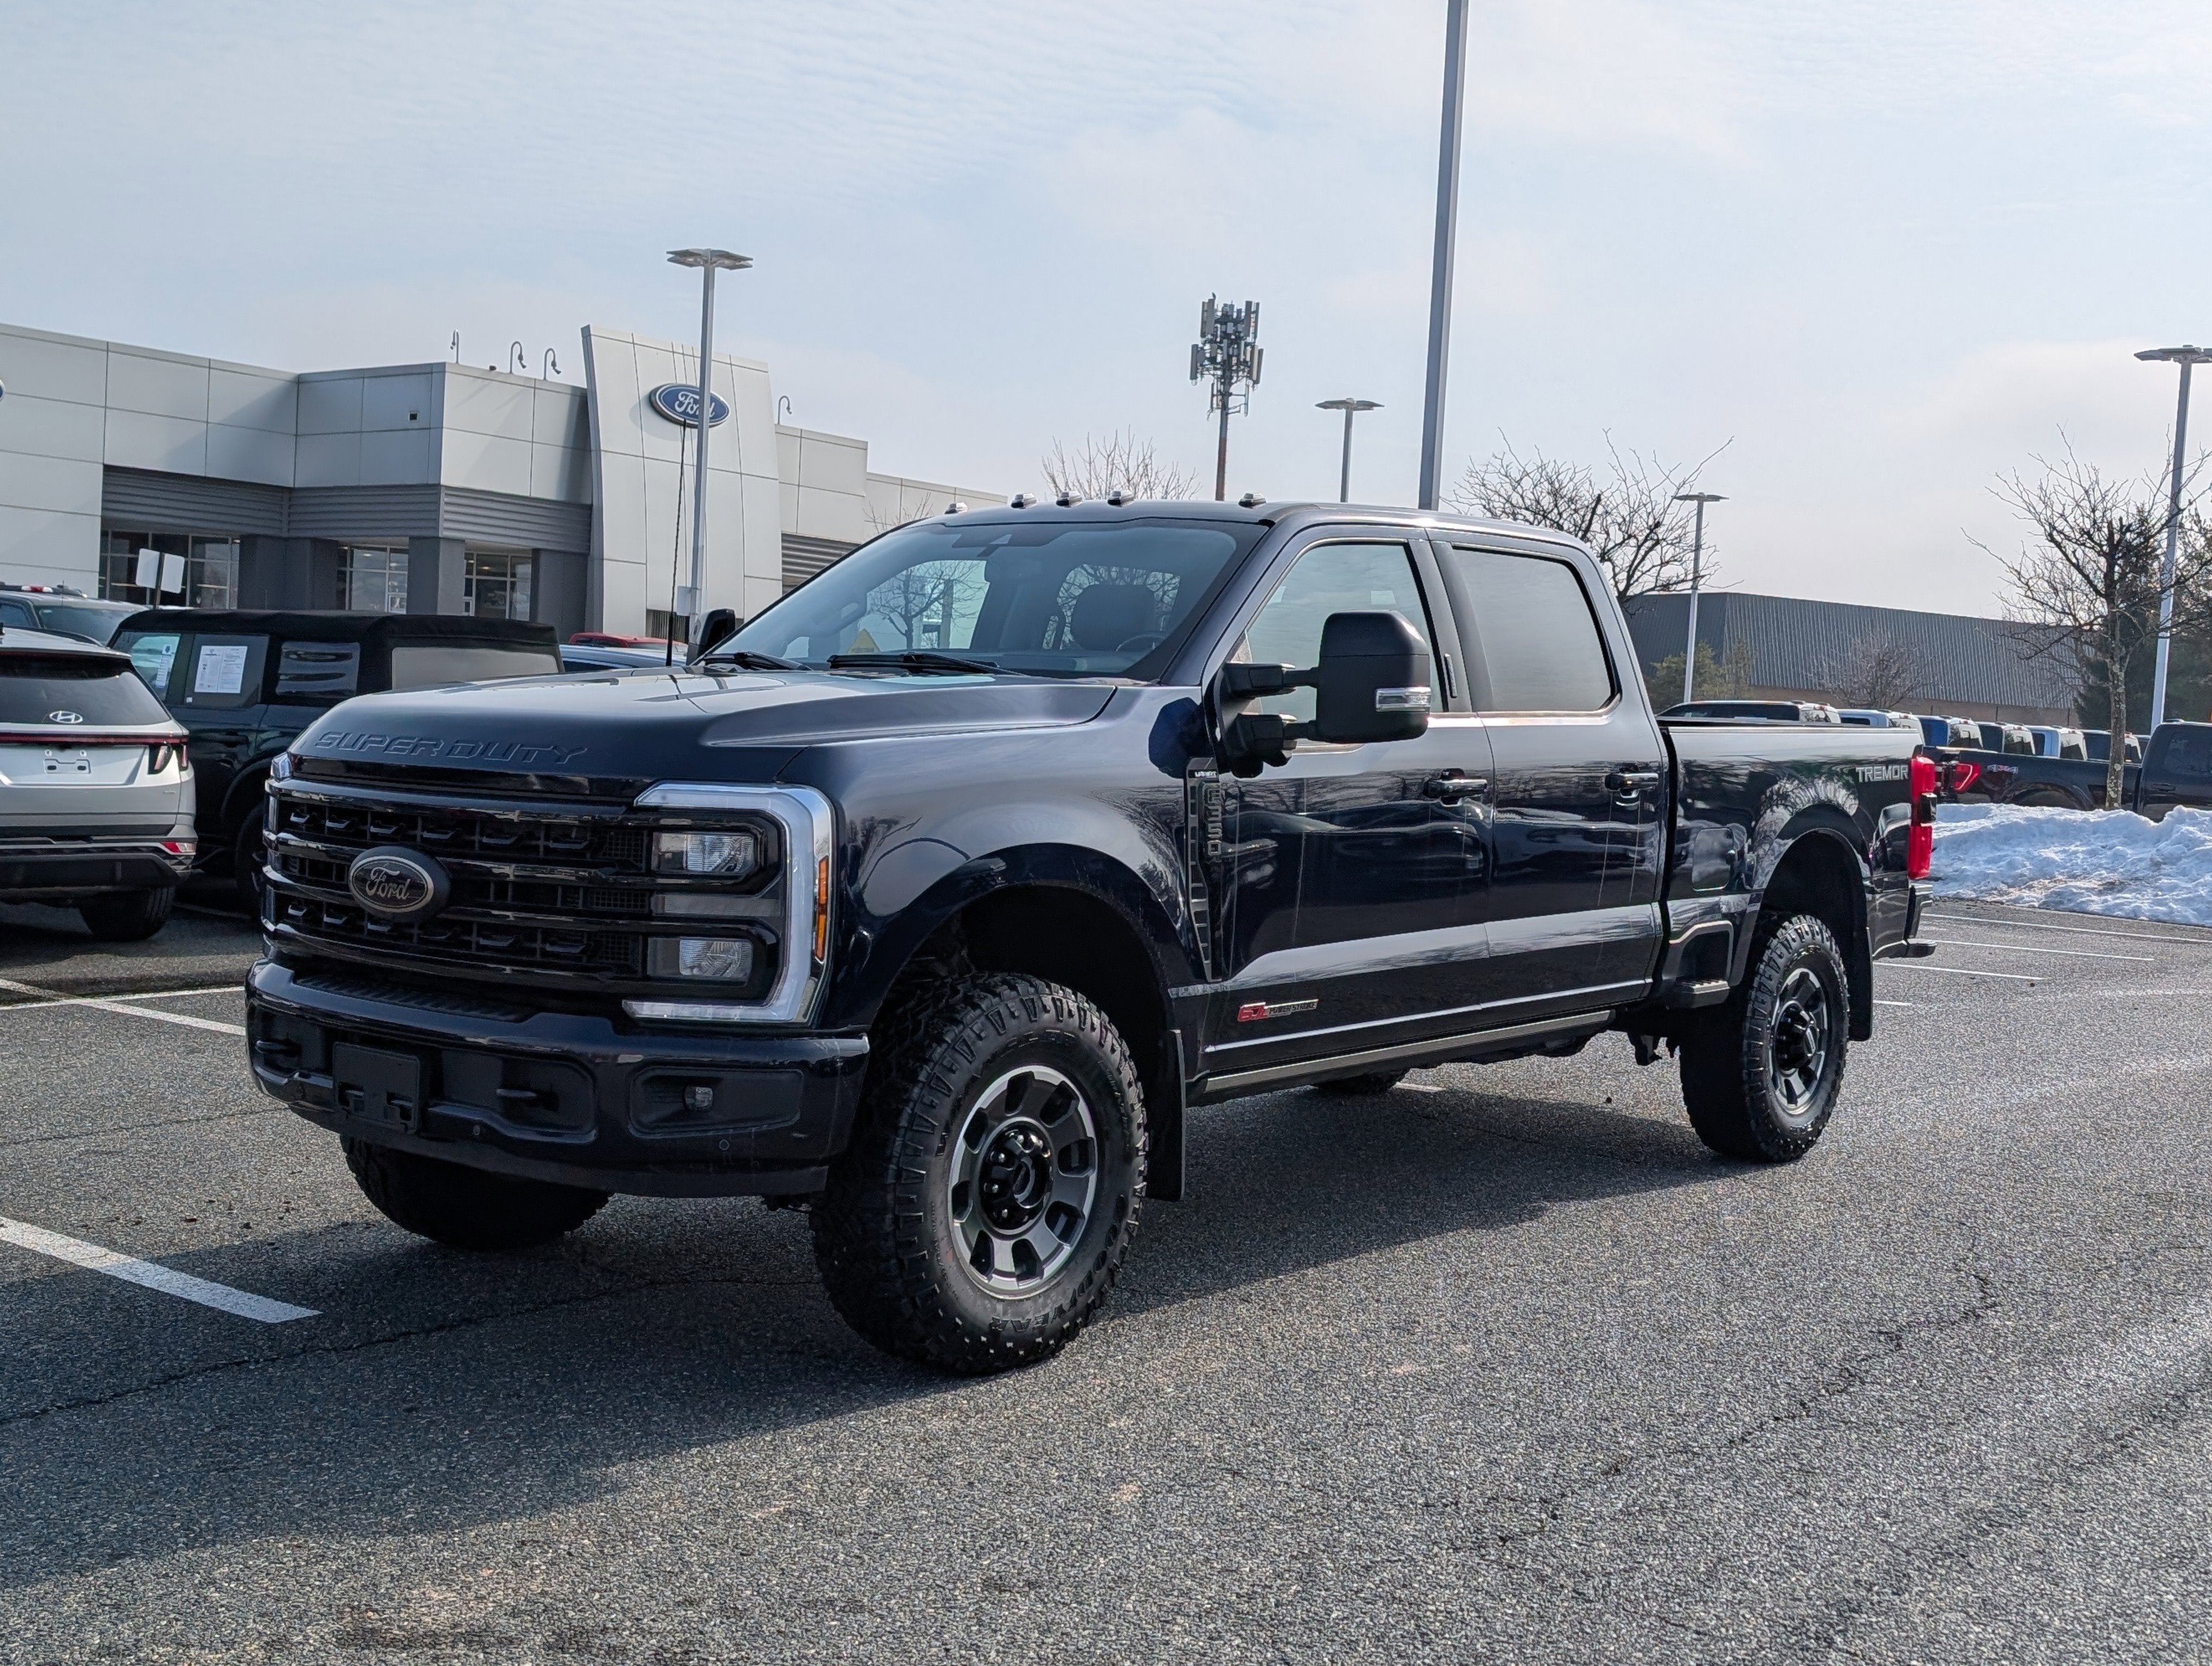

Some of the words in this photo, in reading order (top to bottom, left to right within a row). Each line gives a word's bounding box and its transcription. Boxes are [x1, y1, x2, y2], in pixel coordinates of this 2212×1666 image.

[674, 391, 716, 418] Fod
[315, 731, 444, 757] SUPER
[446, 739, 588, 765] DUTY
[1855, 765, 1909, 783] TREMOR
[365, 867, 410, 900] Ford
